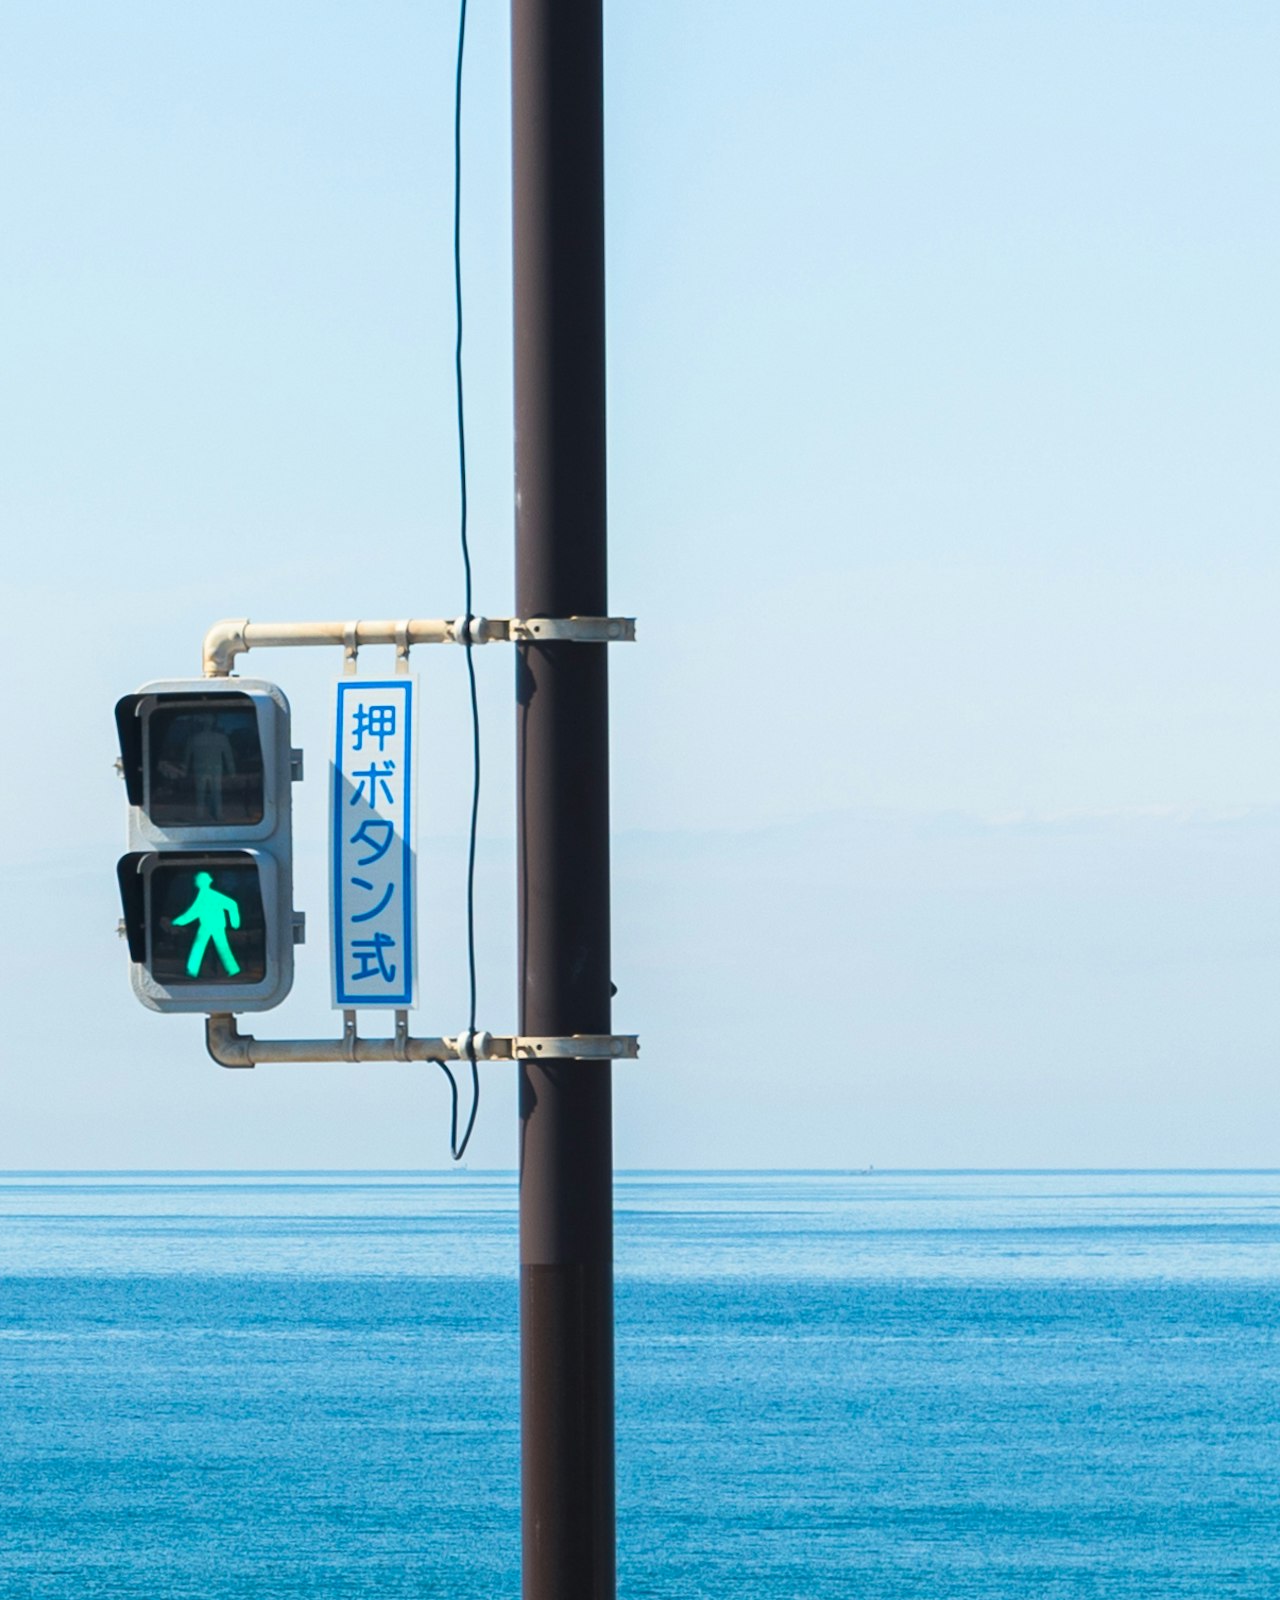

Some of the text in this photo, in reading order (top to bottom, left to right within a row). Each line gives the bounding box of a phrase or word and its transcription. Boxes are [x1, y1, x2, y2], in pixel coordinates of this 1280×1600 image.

[350, 703, 396, 983] 押ボタン式
